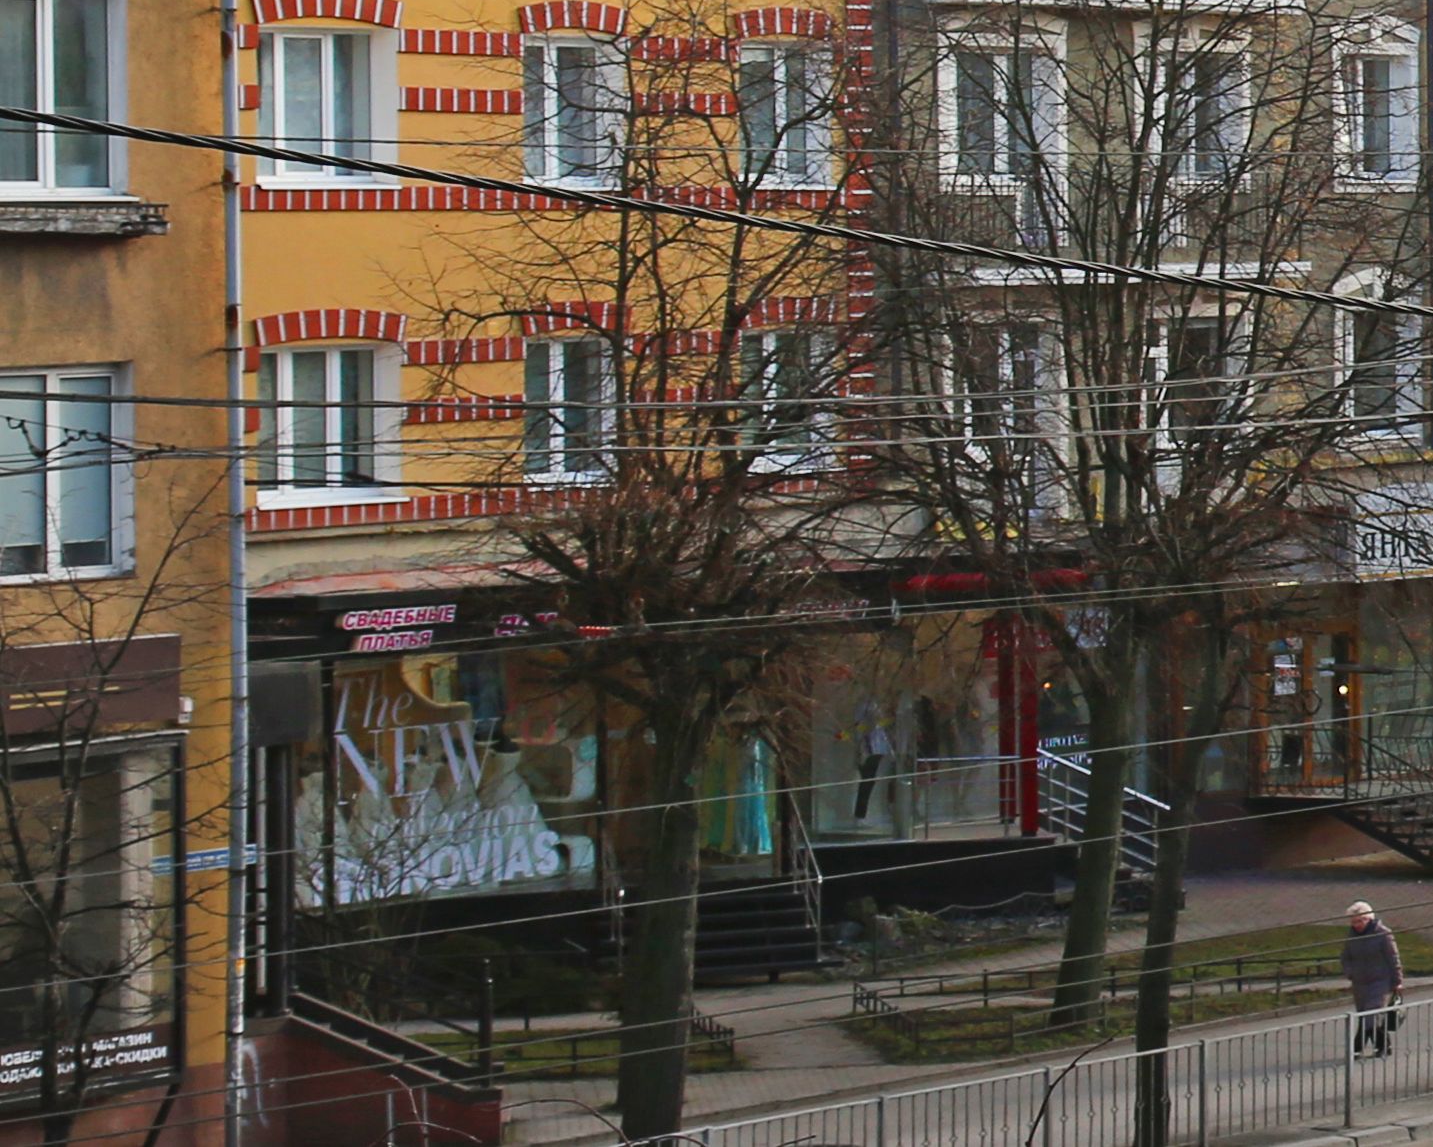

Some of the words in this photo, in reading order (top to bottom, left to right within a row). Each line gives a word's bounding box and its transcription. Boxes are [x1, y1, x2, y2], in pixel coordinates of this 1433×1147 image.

[342, 605, 456, 630] СВАДЕБНЫЕ
[358, 630, 433, 653] ПЛАТЬЯ
[335, 675, 413, 737] The
[334, 716, 501, 806] NEW
[92, 1032, 153, 1052] МАГАЗИН
